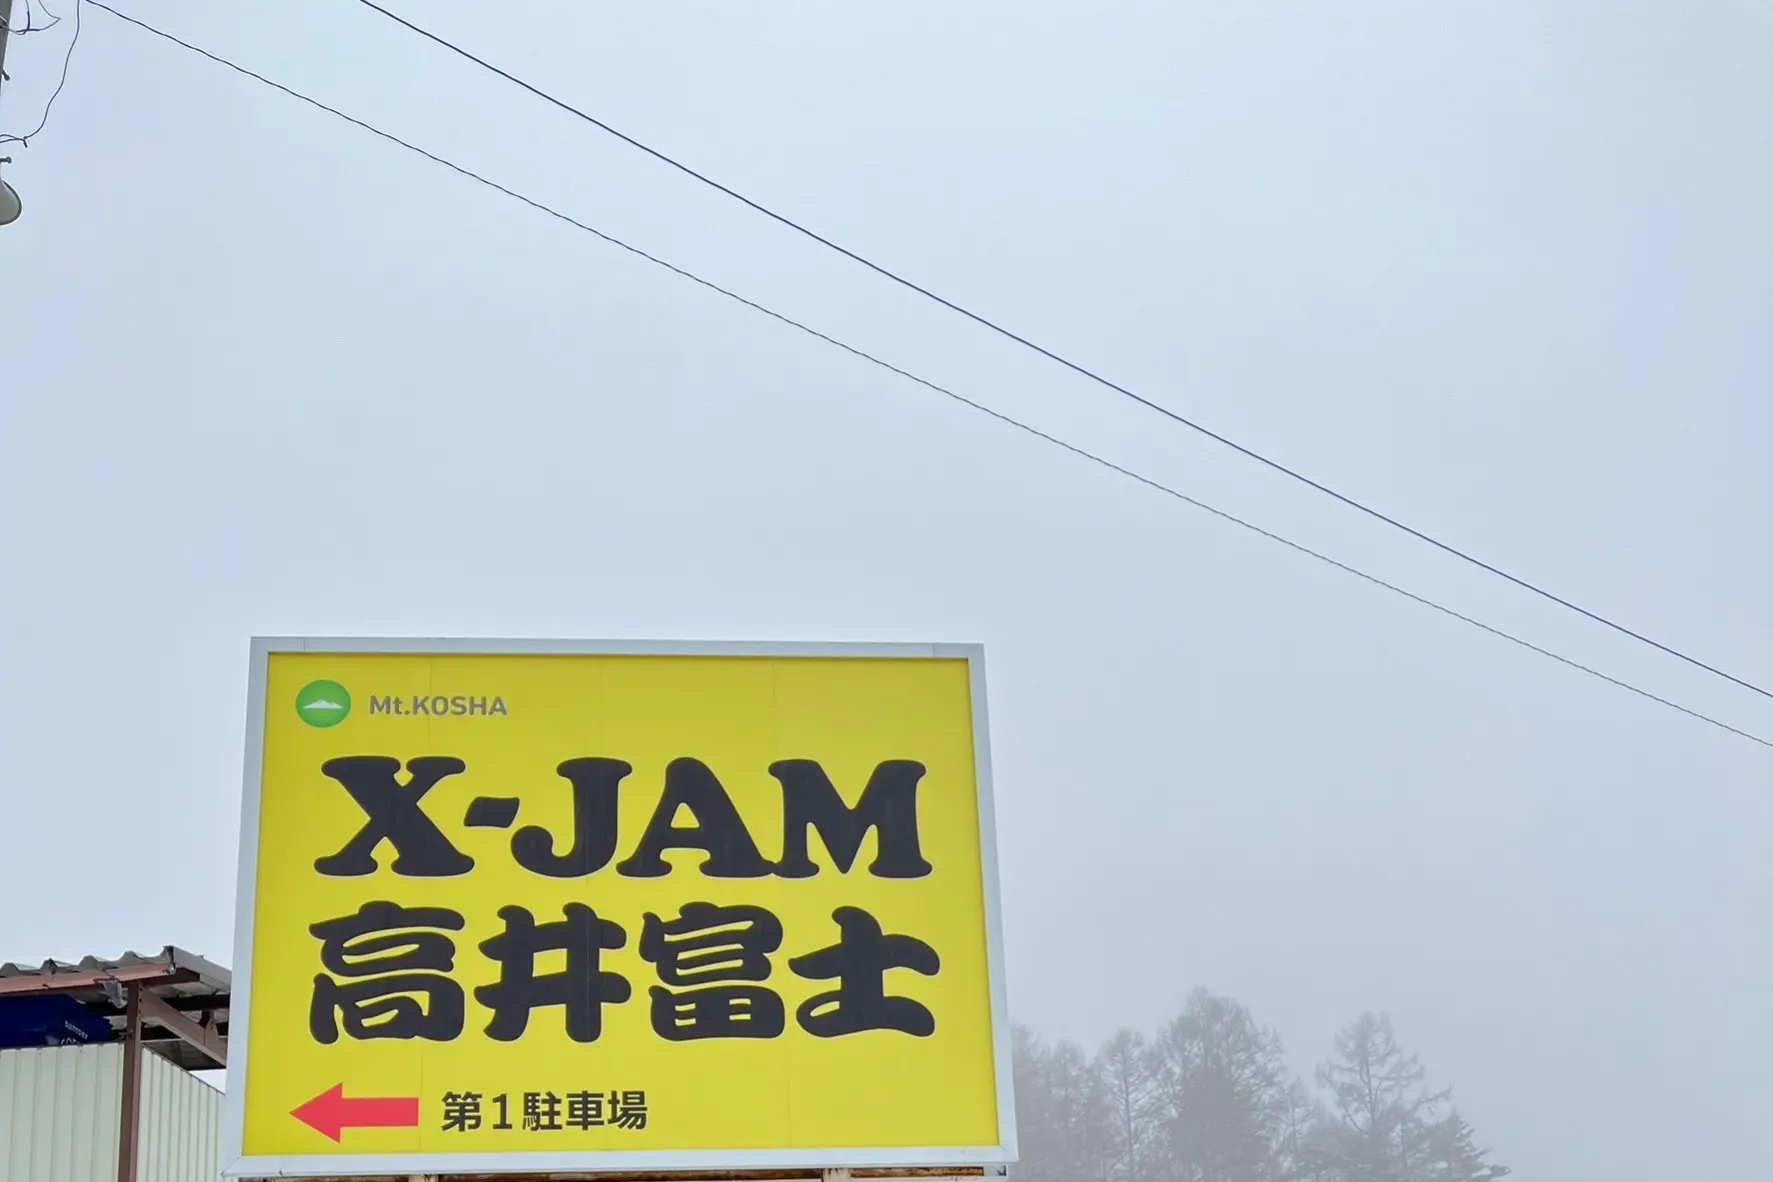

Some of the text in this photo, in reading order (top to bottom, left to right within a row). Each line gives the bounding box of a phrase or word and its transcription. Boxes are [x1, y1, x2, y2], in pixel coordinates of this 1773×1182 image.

[369, 695, 507, 716] Mt.KOSHA
[313, 755, 933, 879] X-JAM
[308, 900, 941, 1046] 高井富士
[441, 1090, 648, 1132] 第1駐車場
